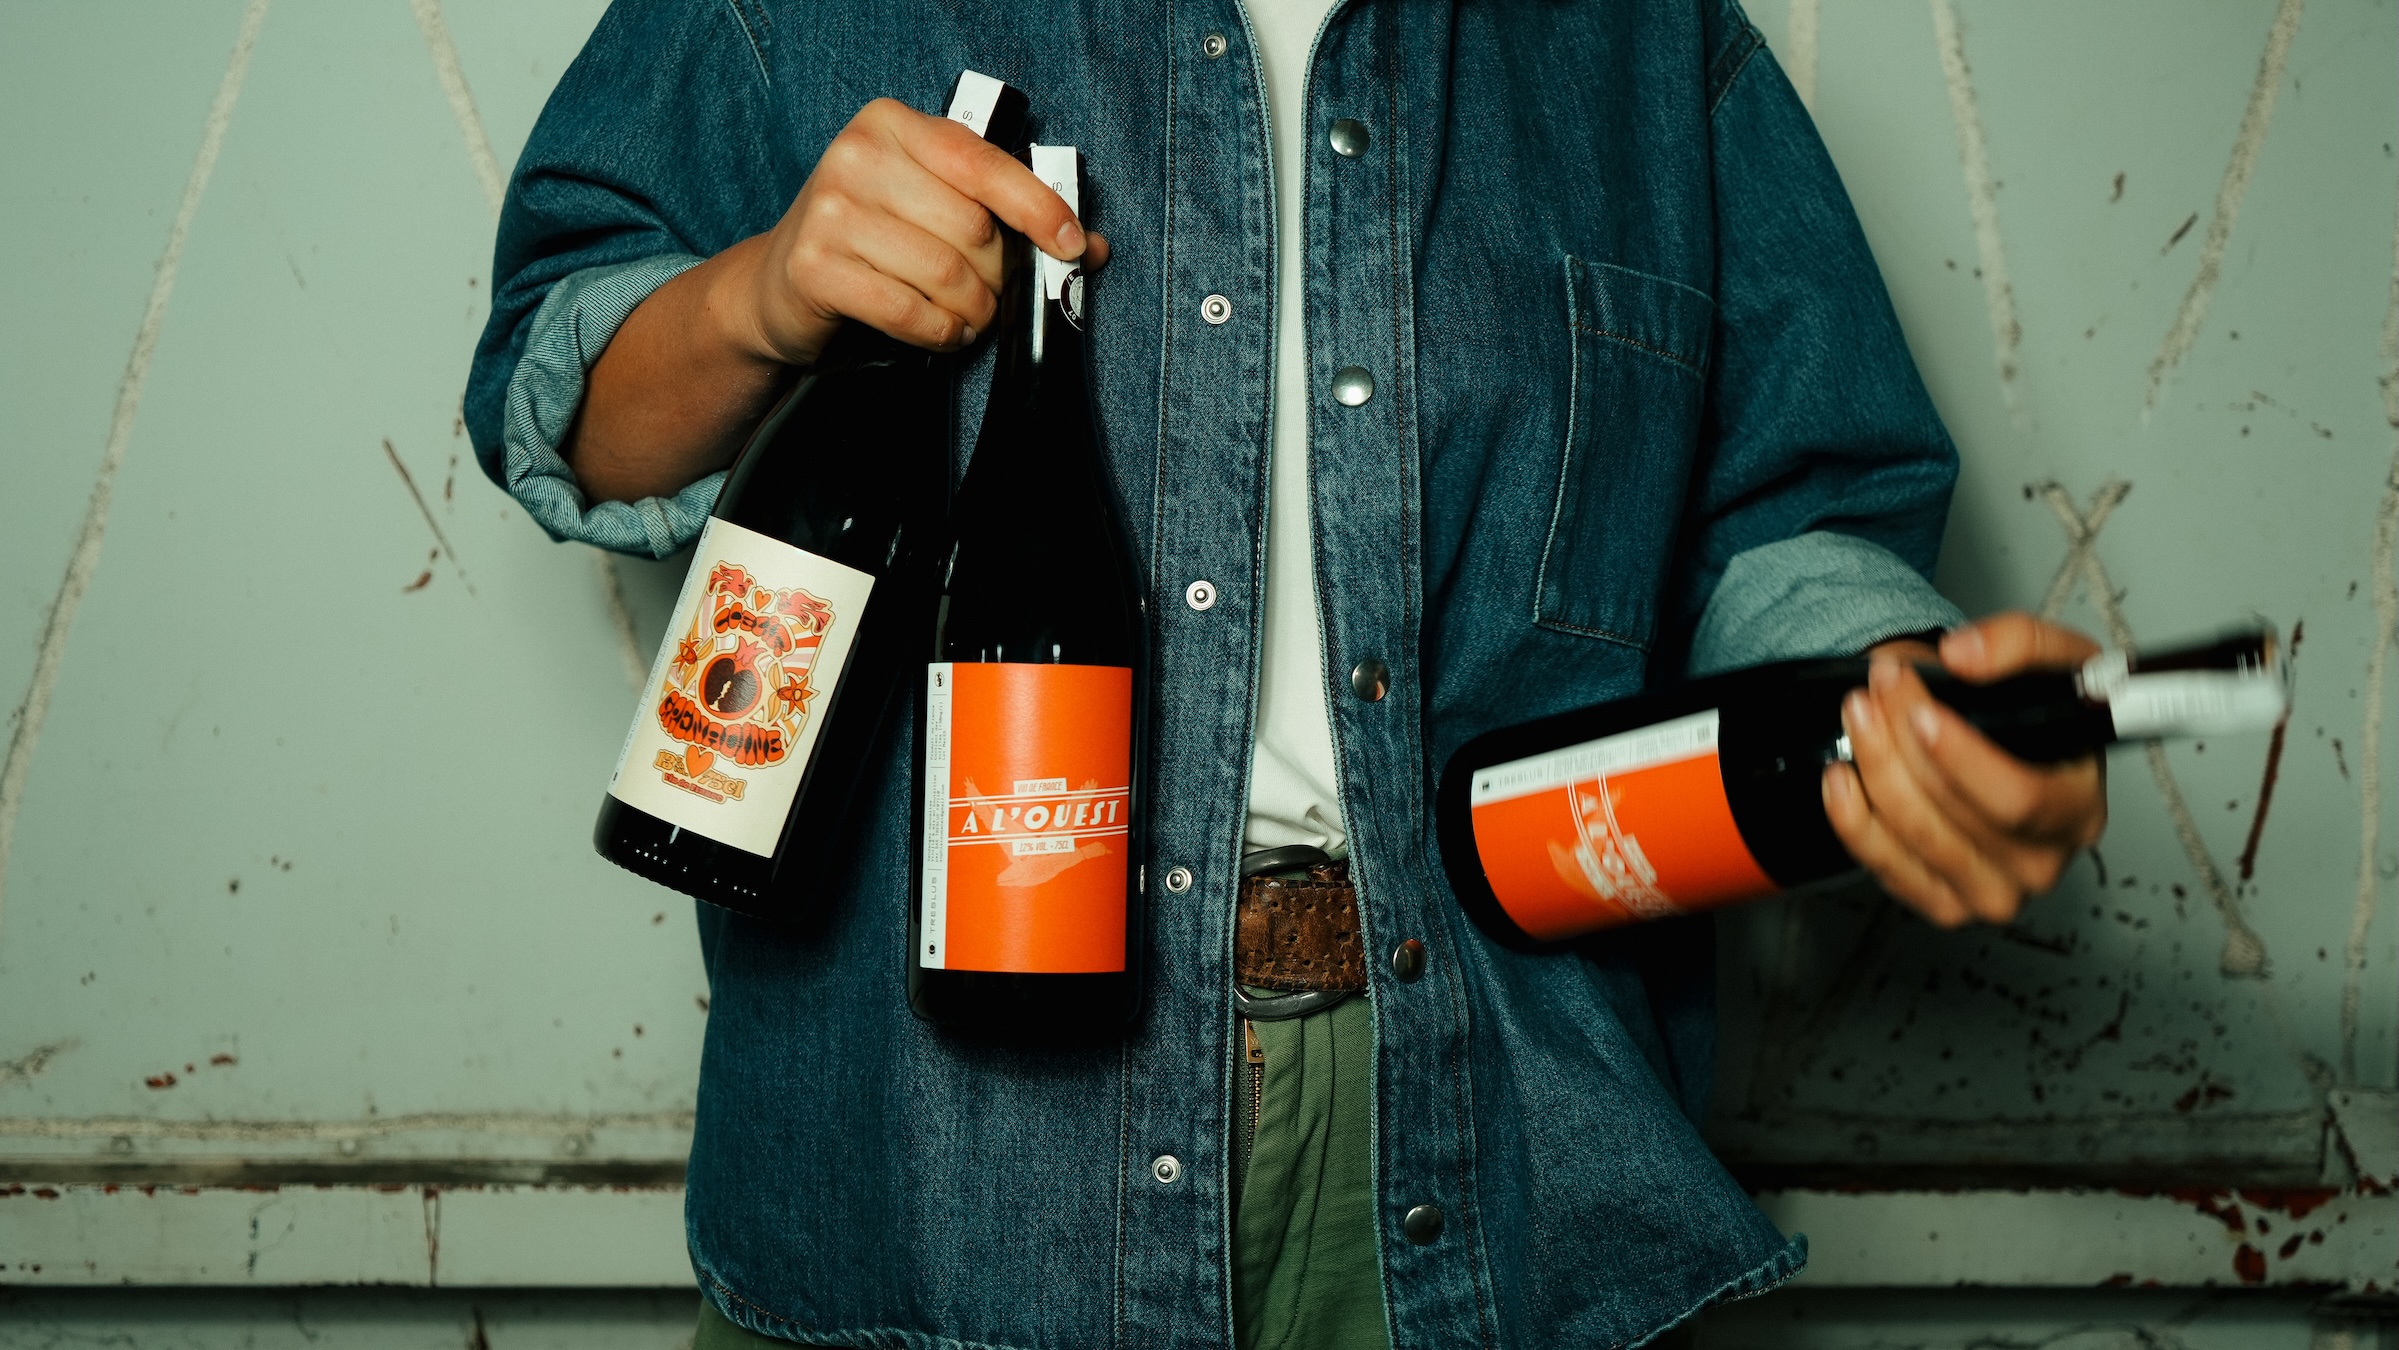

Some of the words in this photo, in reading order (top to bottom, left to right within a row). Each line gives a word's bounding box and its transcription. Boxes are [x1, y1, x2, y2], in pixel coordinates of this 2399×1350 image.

[658, 690, 784, 766] GRENADINE
[1018, 784, 1028, 793] VIN
[1029, 782, 1038, 792] DE
[1038, 782, 1062, 792] FRANCE
[992, 800, 1120, 832] L'OUEST
[1019, 842, 1034, 852] 12%
